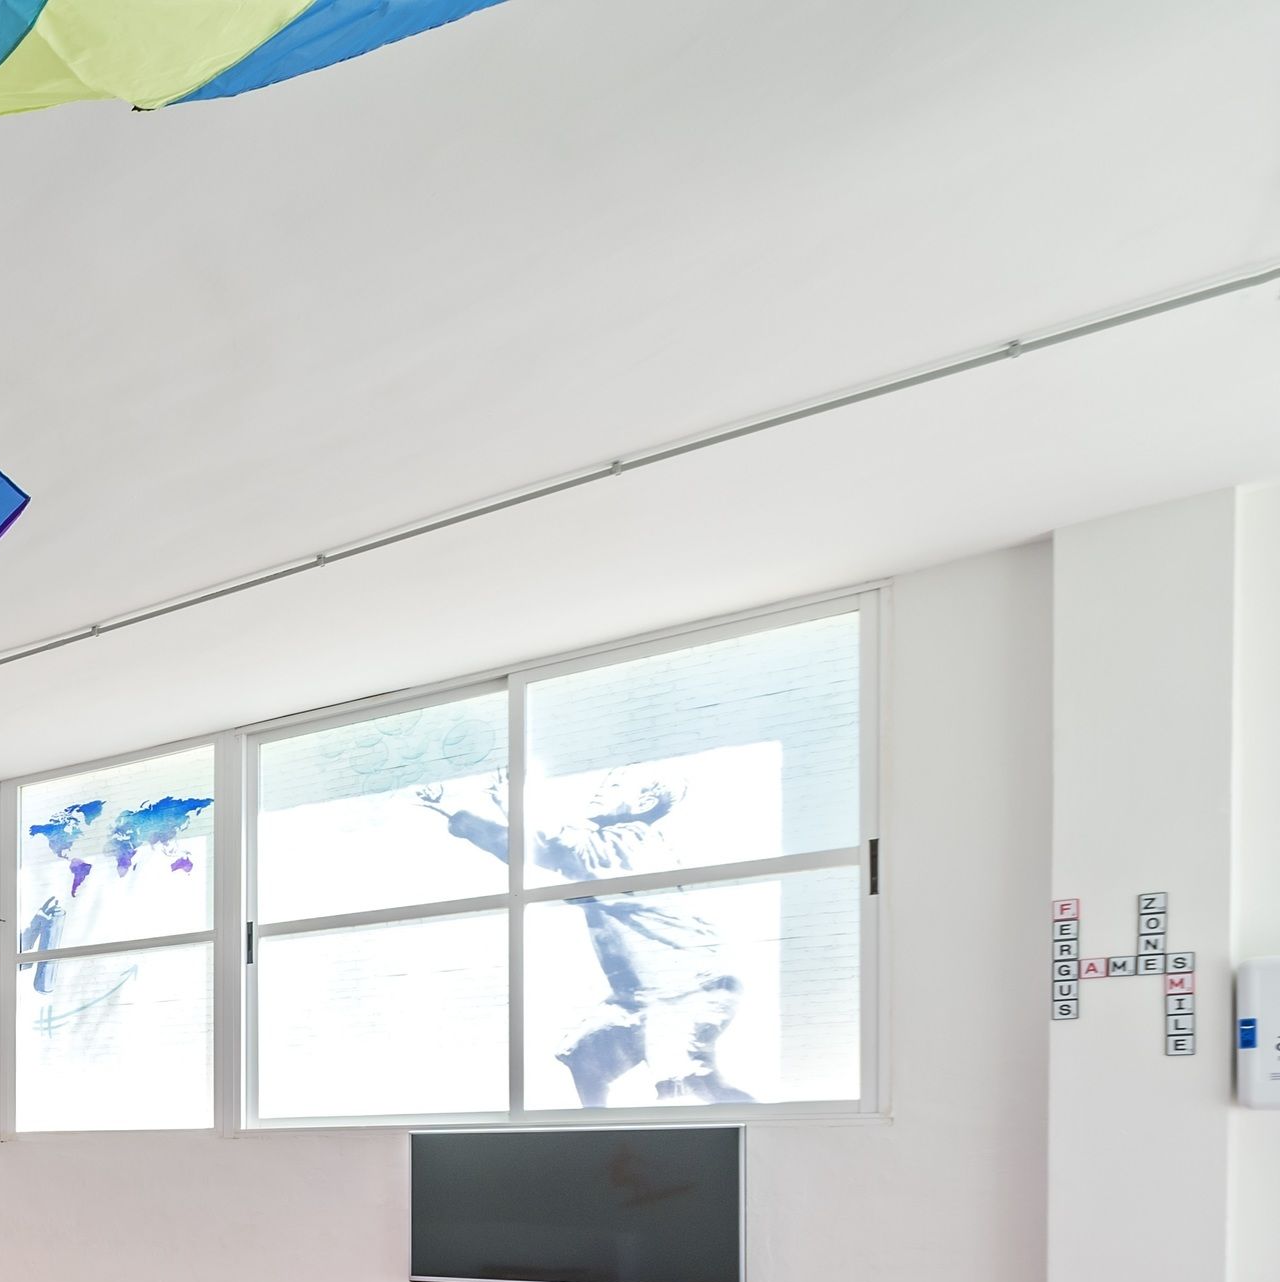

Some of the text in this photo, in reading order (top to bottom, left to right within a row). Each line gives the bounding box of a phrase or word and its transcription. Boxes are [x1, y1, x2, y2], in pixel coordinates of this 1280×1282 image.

[1055, 901, 1076, 1017] FERGUS
[1056, 955, 1190, 978] GAMES
[1139, 895, 1162, 973] ZONE
[1168, 955, 1191, 1053] SMILE
